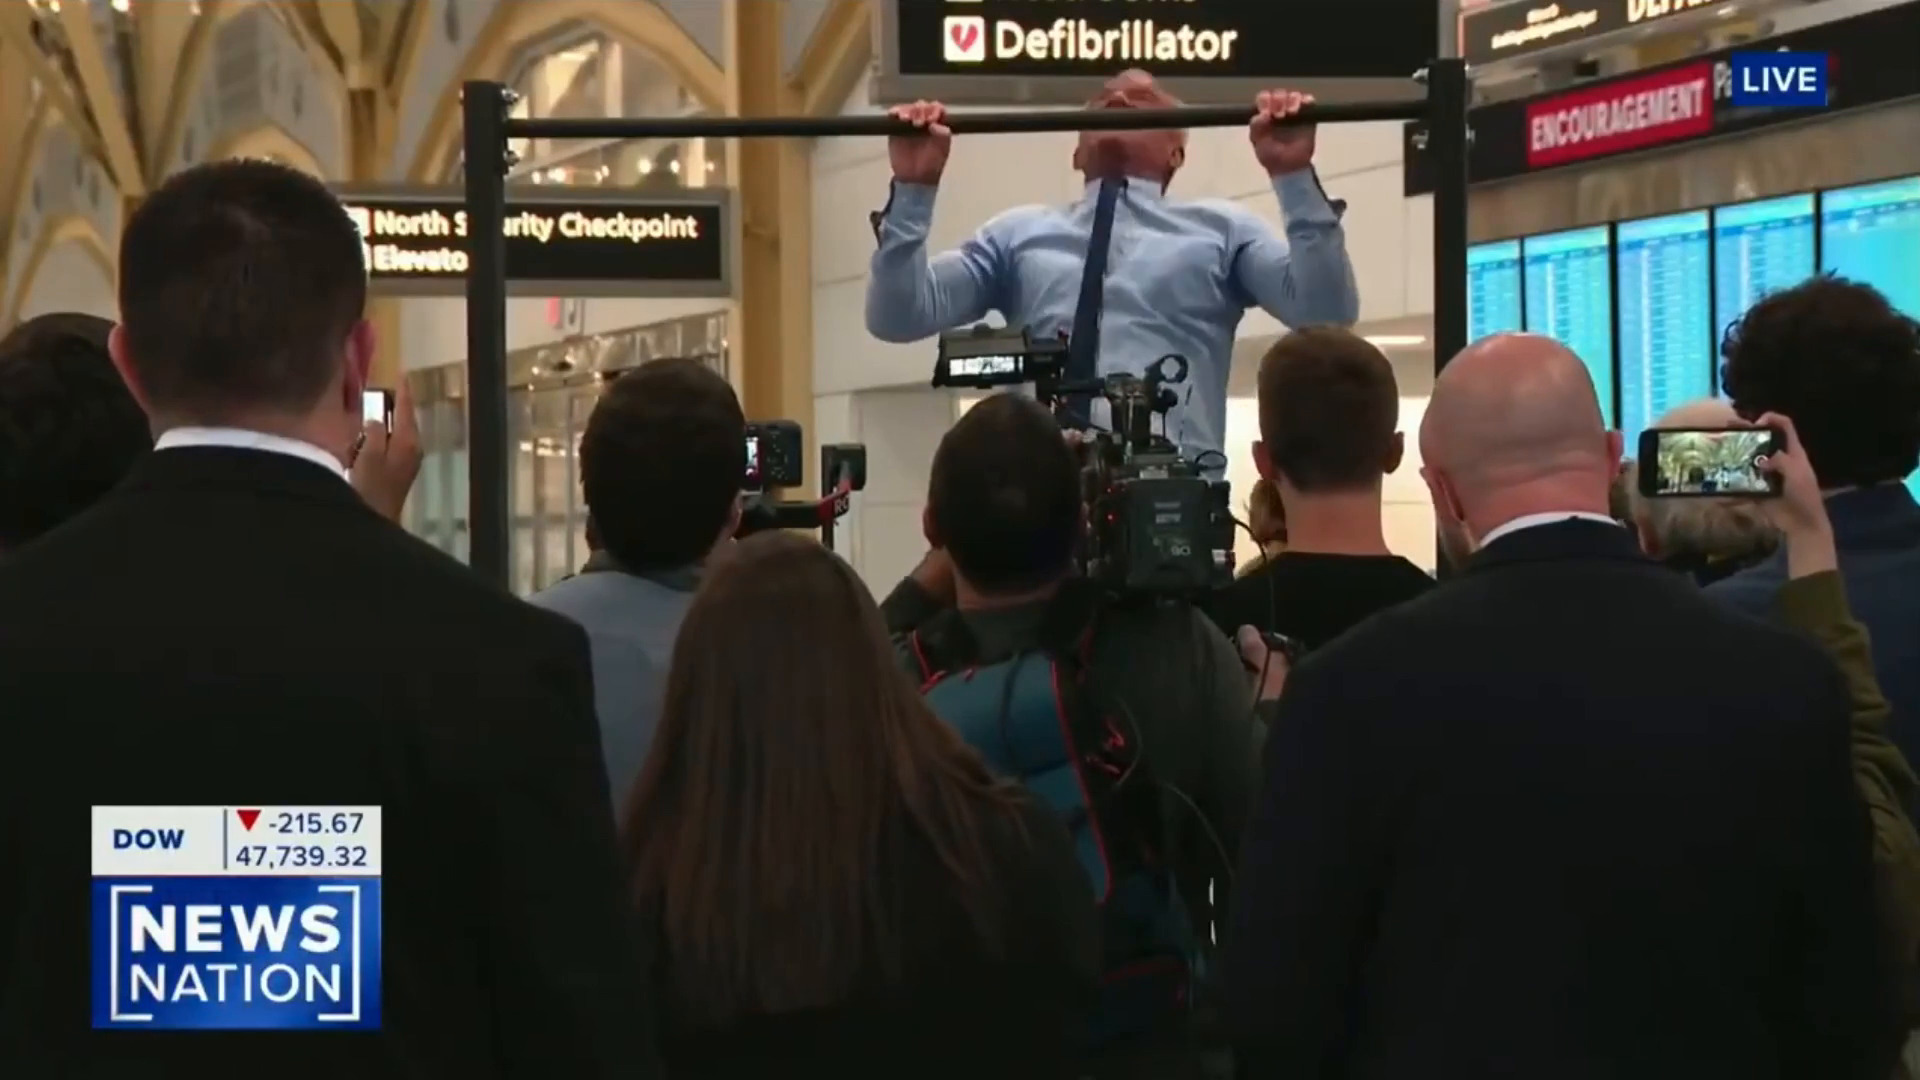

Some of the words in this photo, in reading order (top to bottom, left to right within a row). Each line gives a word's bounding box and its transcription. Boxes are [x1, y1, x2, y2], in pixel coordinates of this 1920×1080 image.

[996, 18, 1238, 60] Defibrillator
[1531, 78, 1706, 151] ENCOURAGEMENT
[373, 209, 449, 237] North
[454, 210, 554, 242] Surity
[558, 211, 698, 242] Checkpoint
[373, 247, 469, 272] Elevato
